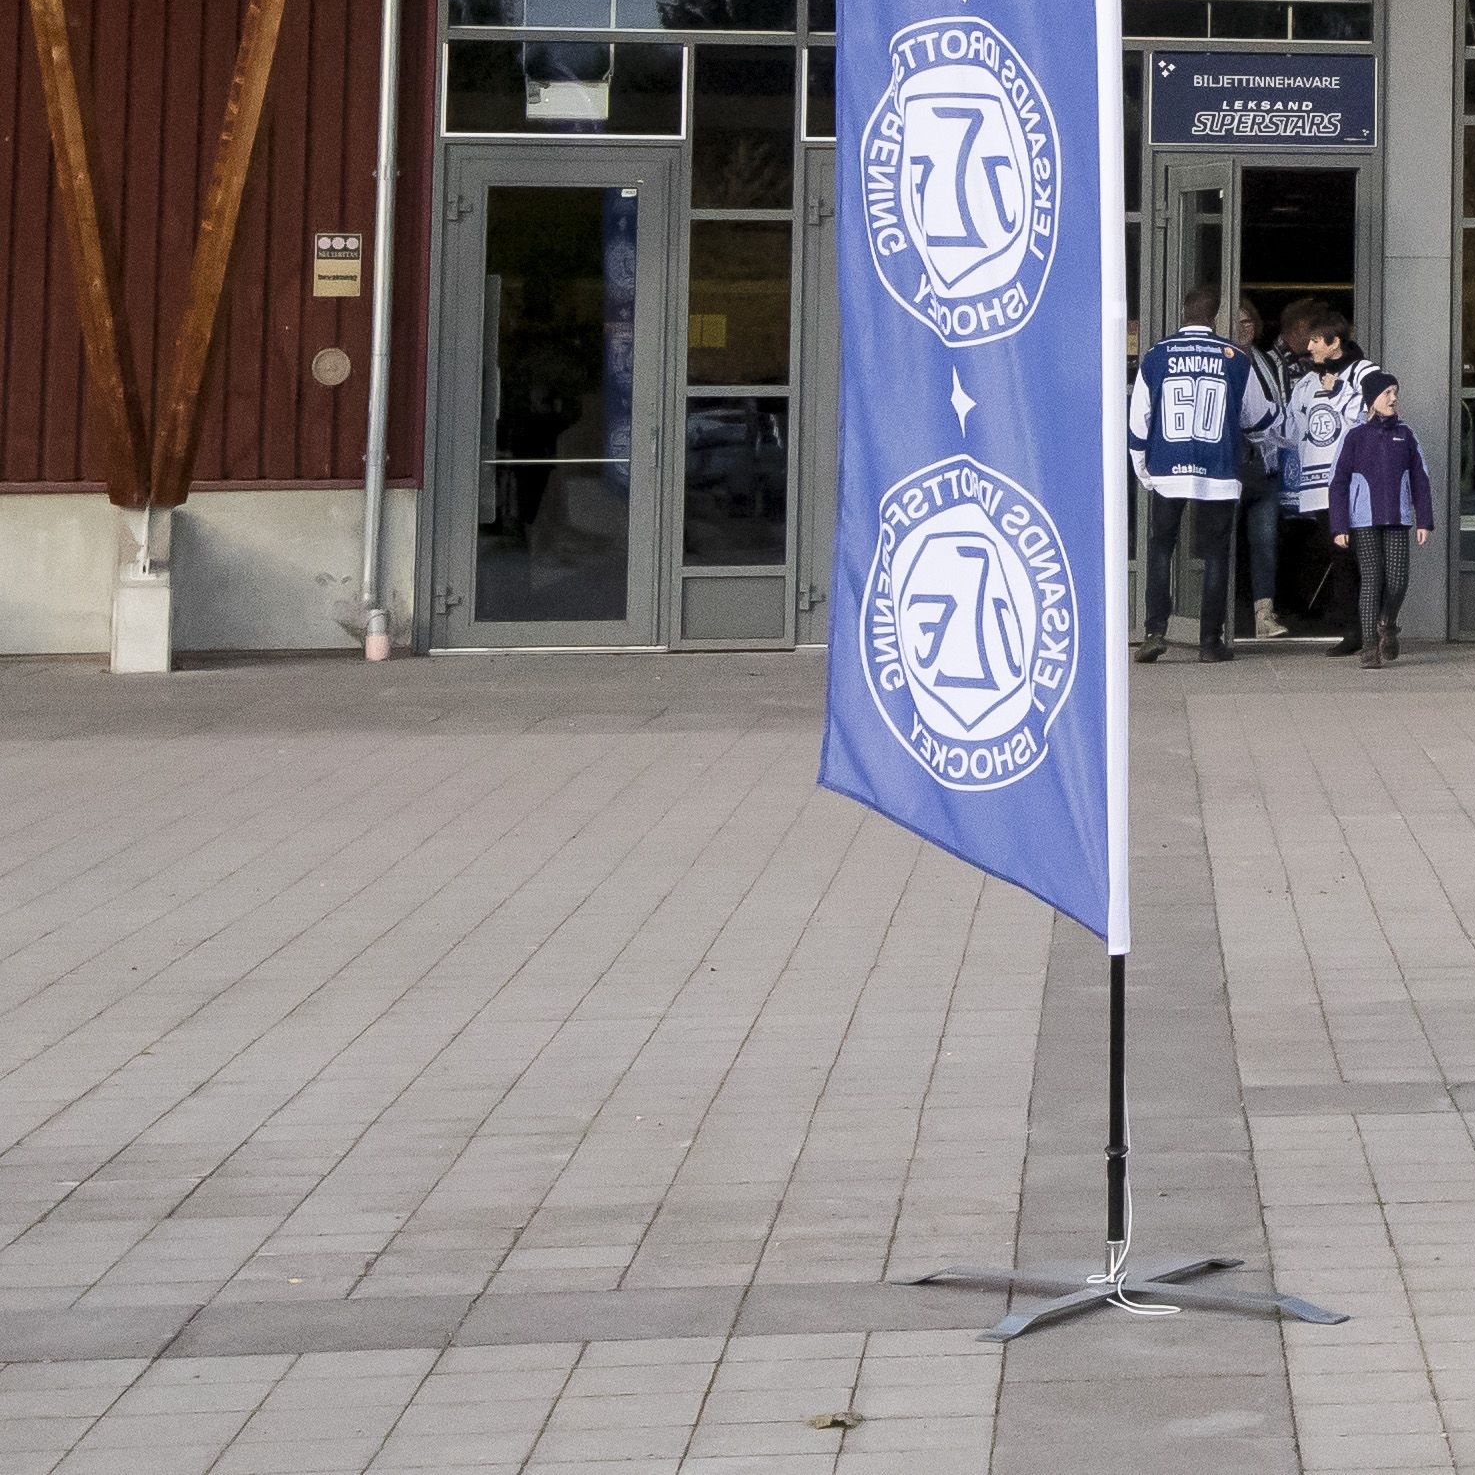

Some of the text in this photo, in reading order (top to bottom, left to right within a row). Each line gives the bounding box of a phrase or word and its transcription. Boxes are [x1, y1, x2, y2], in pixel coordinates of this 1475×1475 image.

[1193, 74, 1341, 89] BILJETTINNEHAVARE
[1222, 100, 1313, 111] LEKSAND
[1168, 356, 1225, 376] SANDAHL
[1161, 376, 1228, 444] 60
